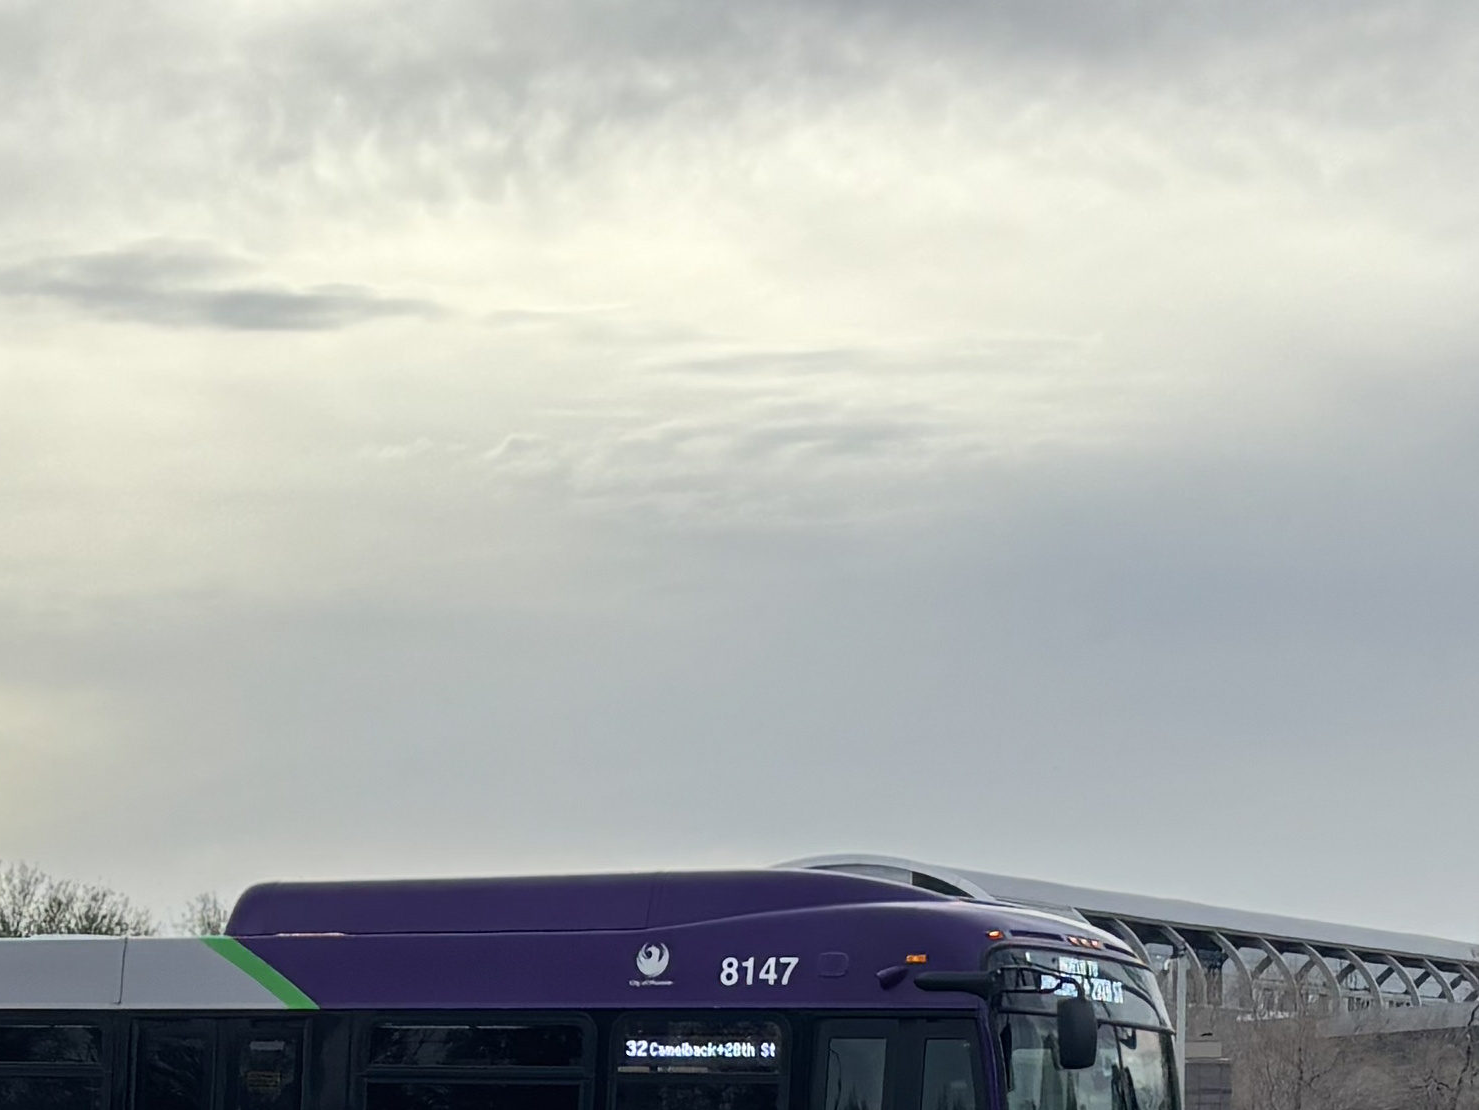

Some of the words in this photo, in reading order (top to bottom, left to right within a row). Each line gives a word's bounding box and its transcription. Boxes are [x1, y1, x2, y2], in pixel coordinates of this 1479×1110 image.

[720, 956, 799, 986] 8147
[625, 1040, 648, 1057] 32
[760, 1042, 776, 1058] St
